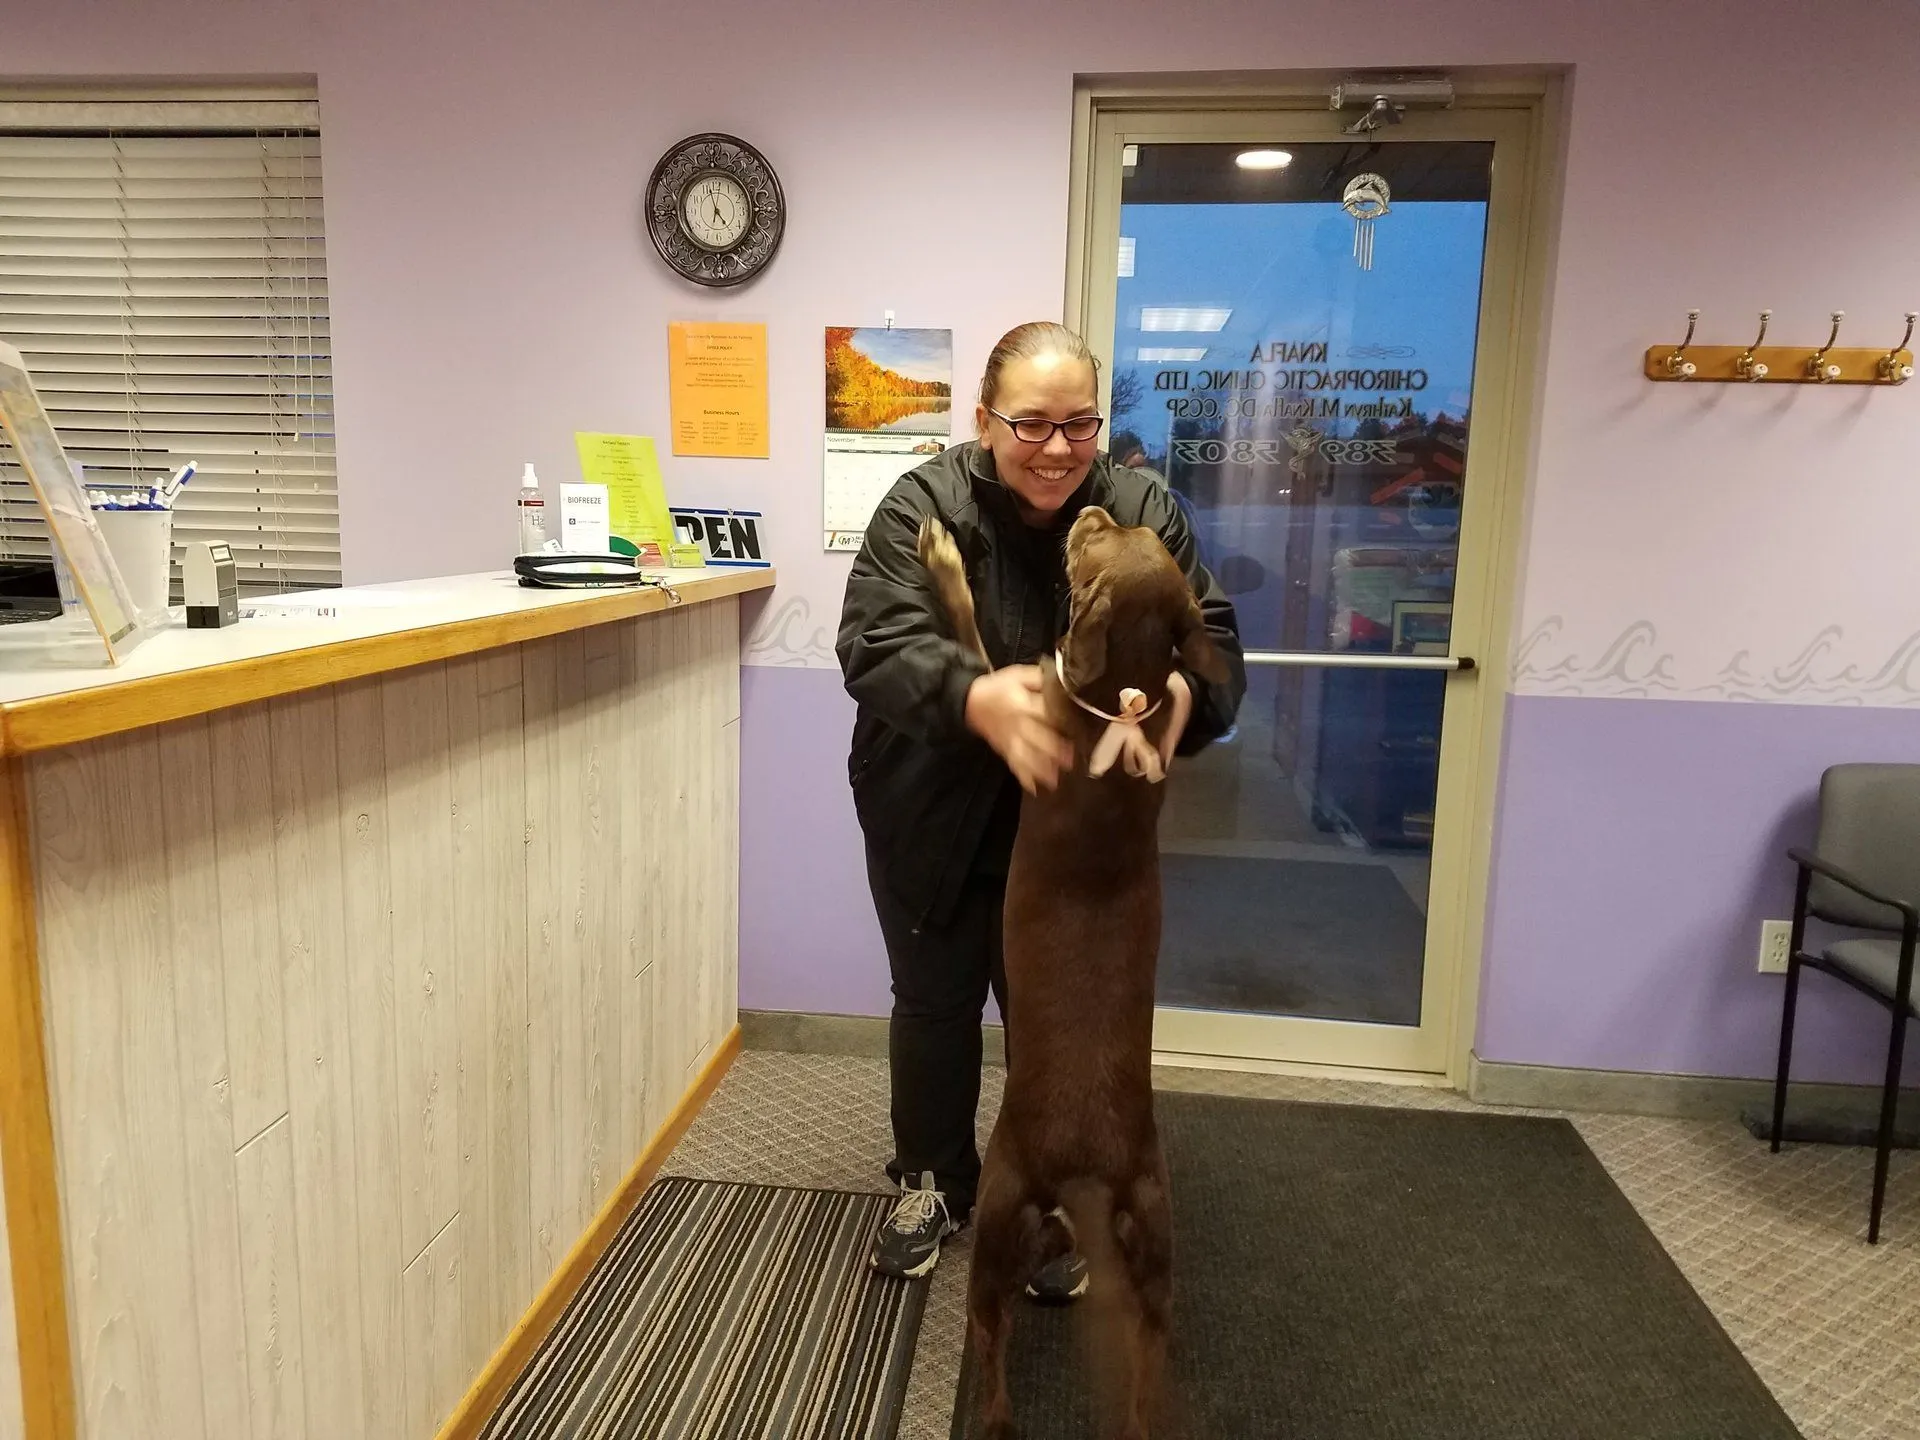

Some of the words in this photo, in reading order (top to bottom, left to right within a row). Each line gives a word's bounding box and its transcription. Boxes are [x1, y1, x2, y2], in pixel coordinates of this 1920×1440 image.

[712, 181, 721, 191] 12
[693, 195, 703, 204] 10
[734, 194, 741, 204] 2
[739, 206, 745, 217] 3
[735, 219, 741, 230] 4
[704, 228, 710, 239] 7
[715, 232, 722, 242] 6
[567, 496, 602, 504] BIOFREEZE
[674, 515, 762, 560] PEN
